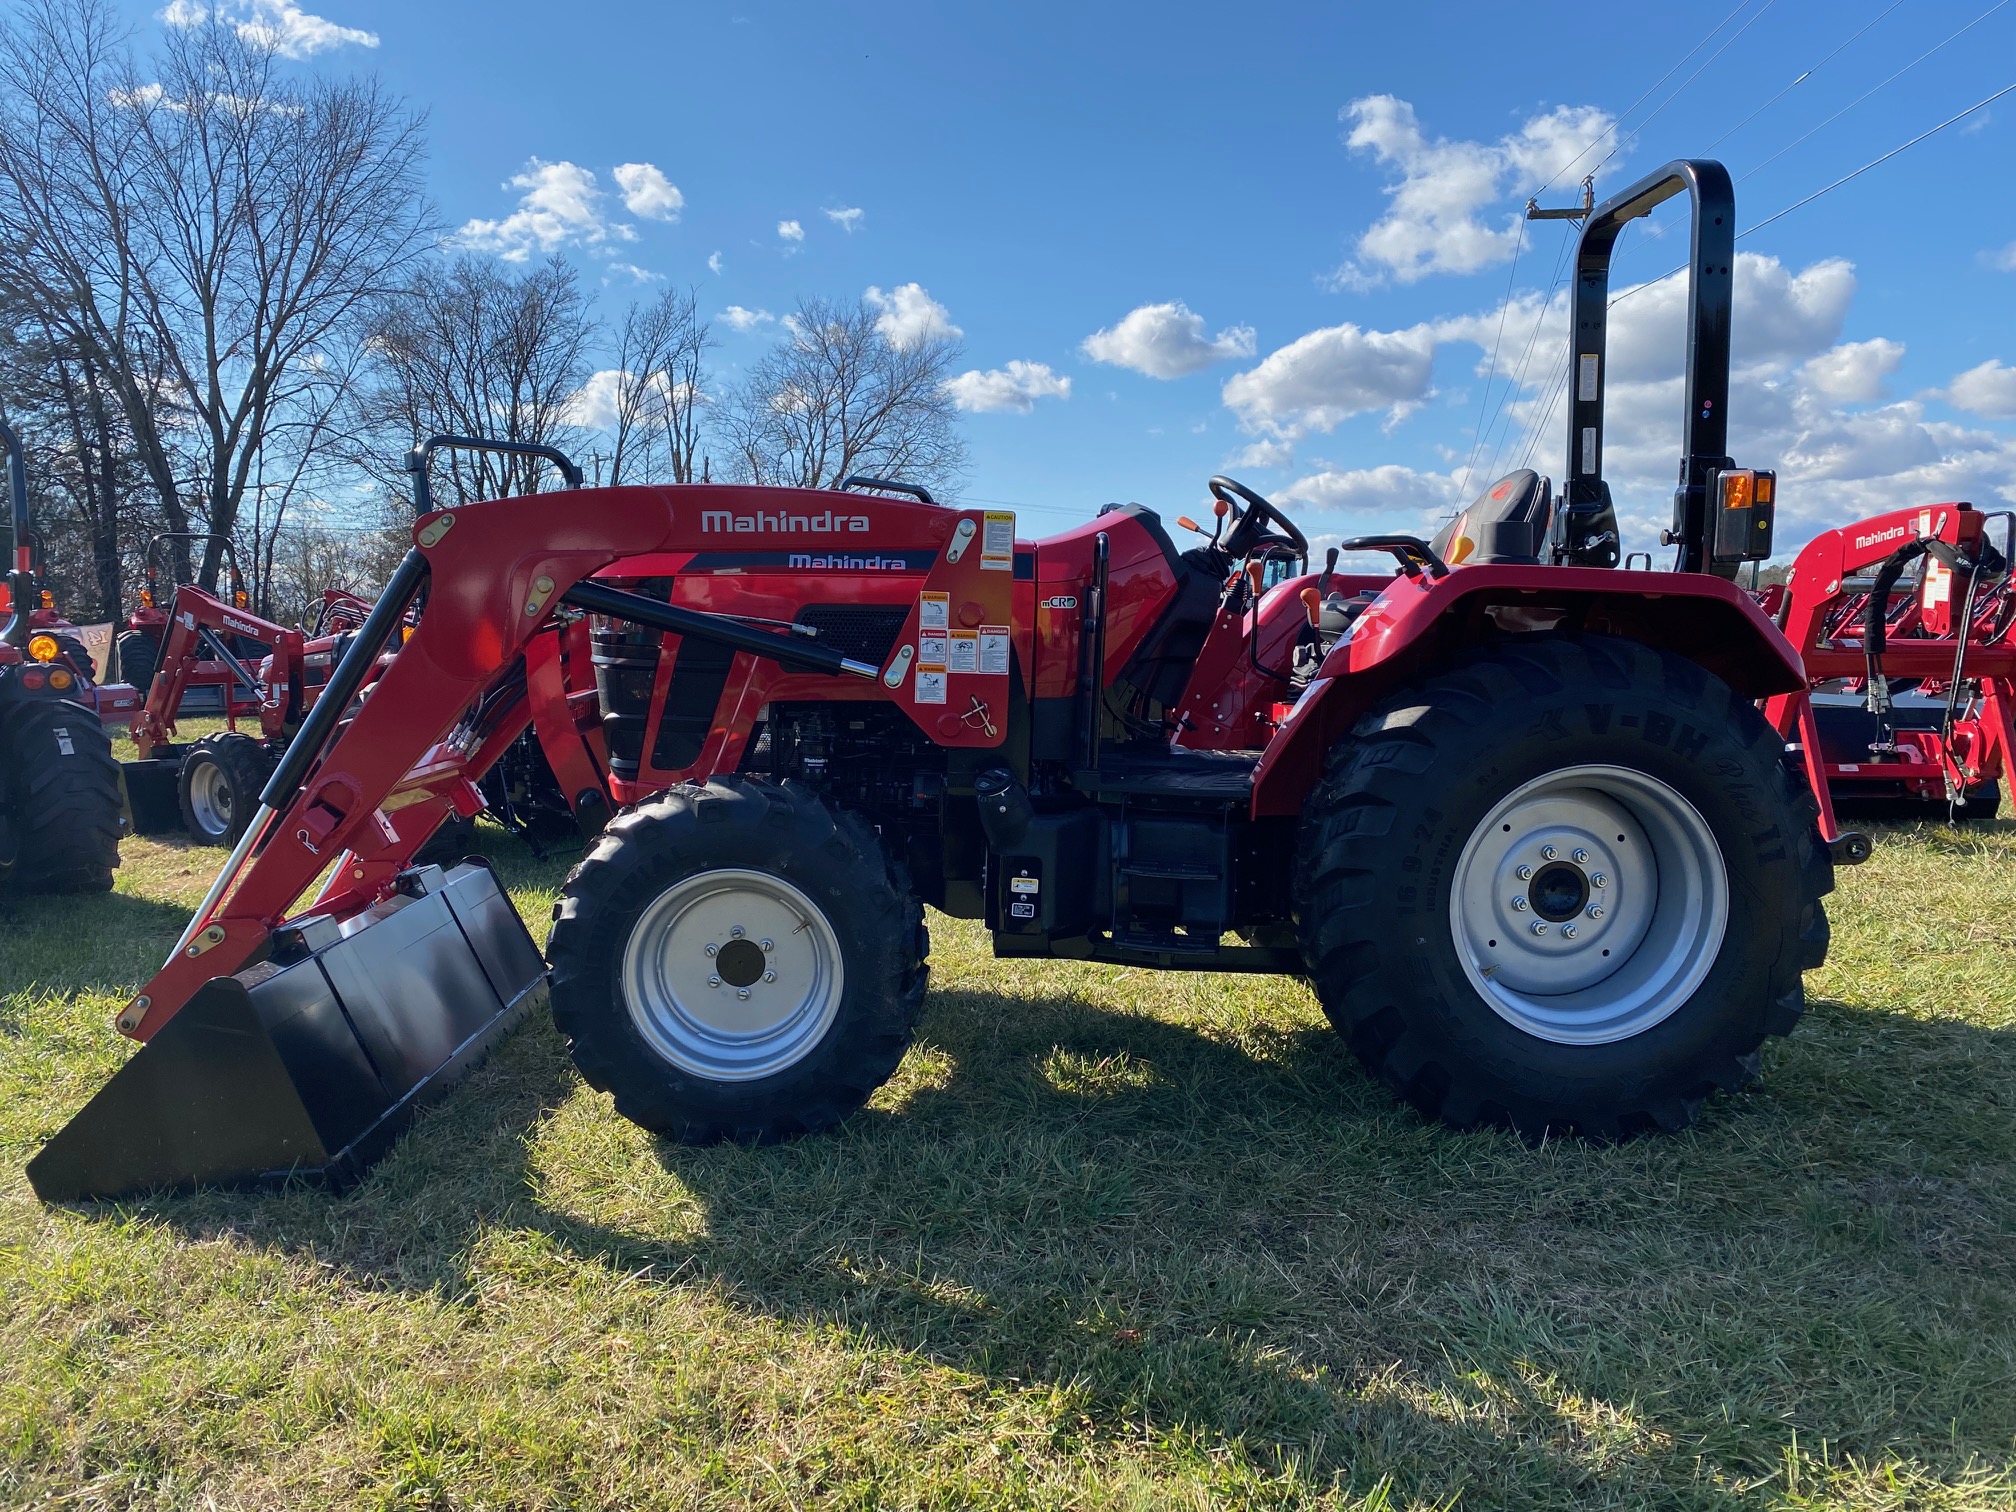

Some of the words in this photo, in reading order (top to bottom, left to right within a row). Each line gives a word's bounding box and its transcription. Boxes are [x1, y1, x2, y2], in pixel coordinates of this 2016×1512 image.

[701, 511, 870, 533] Mahindra
[1855, 526, 1905, 550] Mahindra
[788, 554, 907, 570] Mahindra
[222, 614, 260, 637] Mahindra
[1396, 807, 1444, 918] 16.9-24
[1426, 824, 1459, 912] INDUSTRIAL
